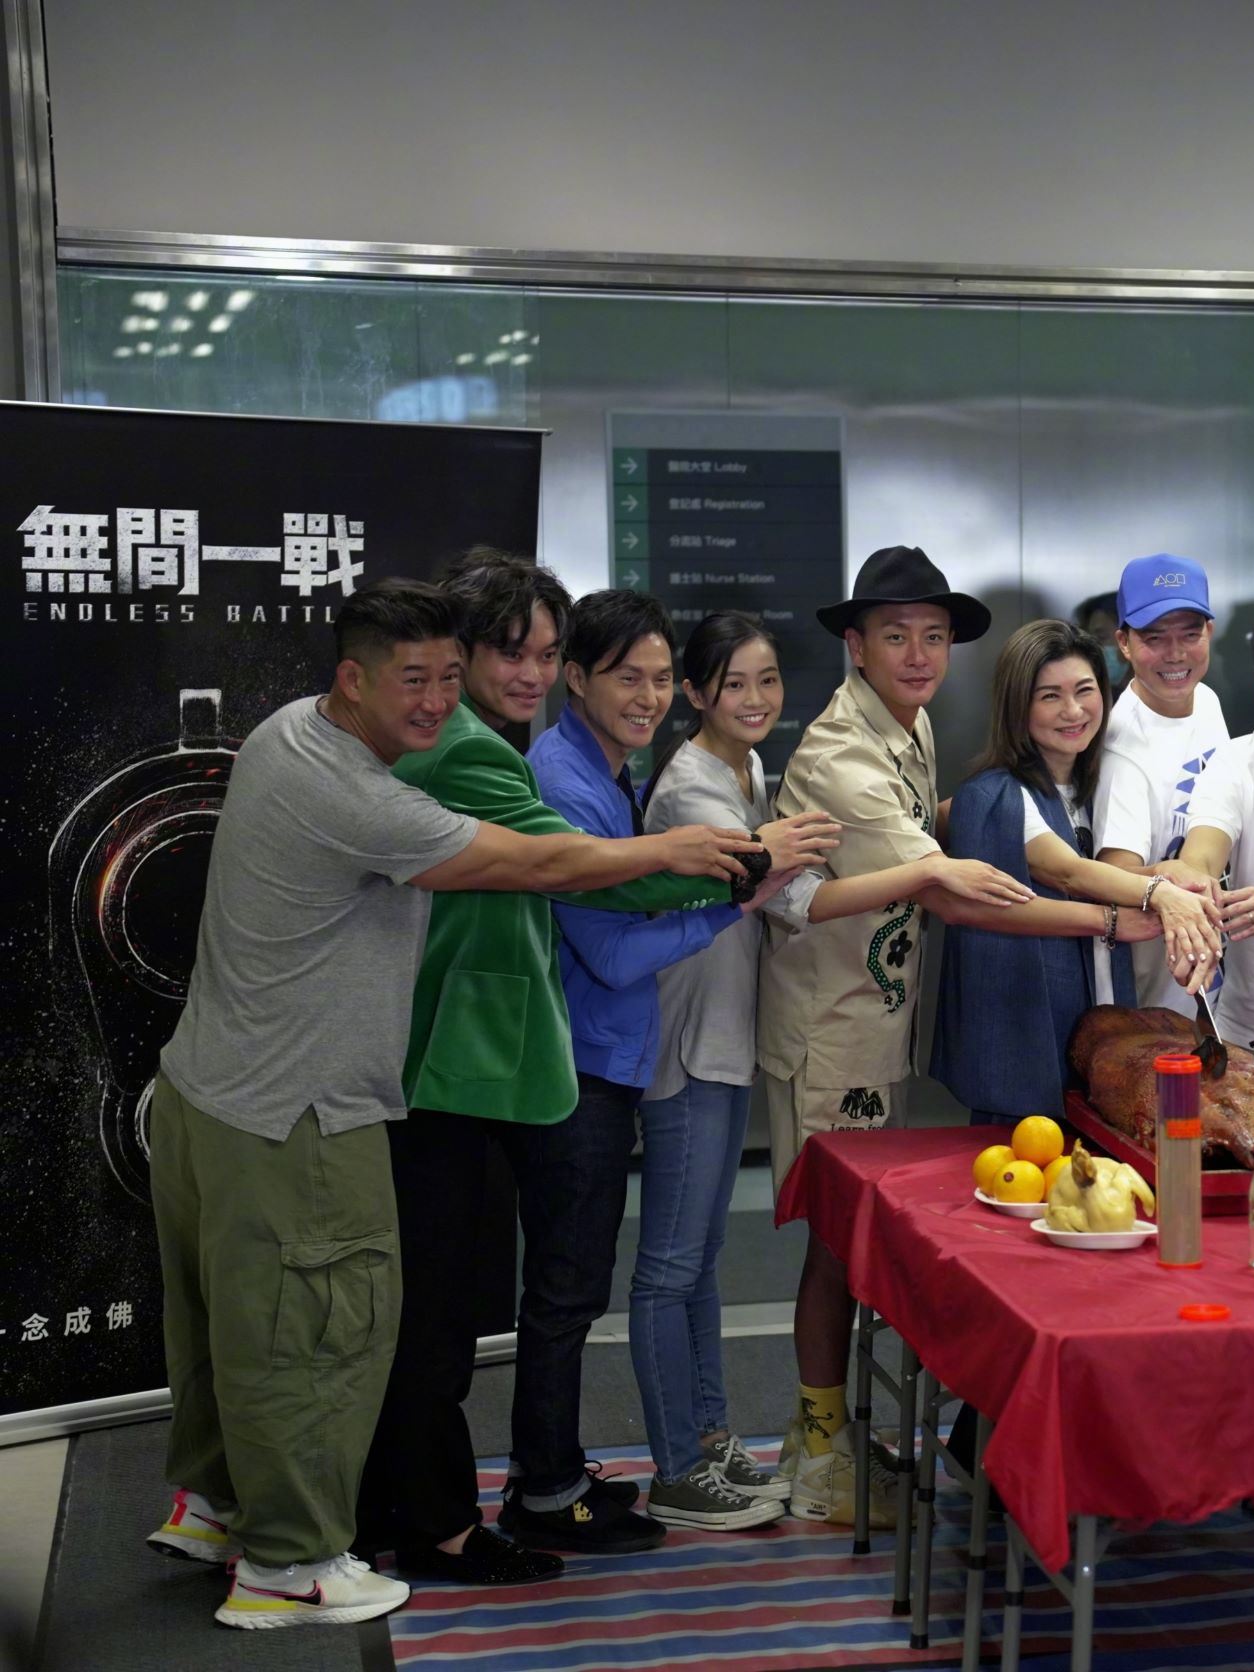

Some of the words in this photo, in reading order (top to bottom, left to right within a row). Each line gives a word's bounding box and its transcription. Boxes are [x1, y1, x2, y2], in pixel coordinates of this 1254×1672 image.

[714, 461, 747, 474] Lobby
[704, 498, 765, 511] Registration
[704, 535, 736, 548] Triage
[16, 504, 365, 597] 無間一戰
[705, 573, 735, 583] Nurse
[737, 573, 775, 583] Station
[23, 602, 195, 623] ENDLESS
[226, 604, 336, 624] BATTL
[0, 1300, 133, 1341] 念成佛
